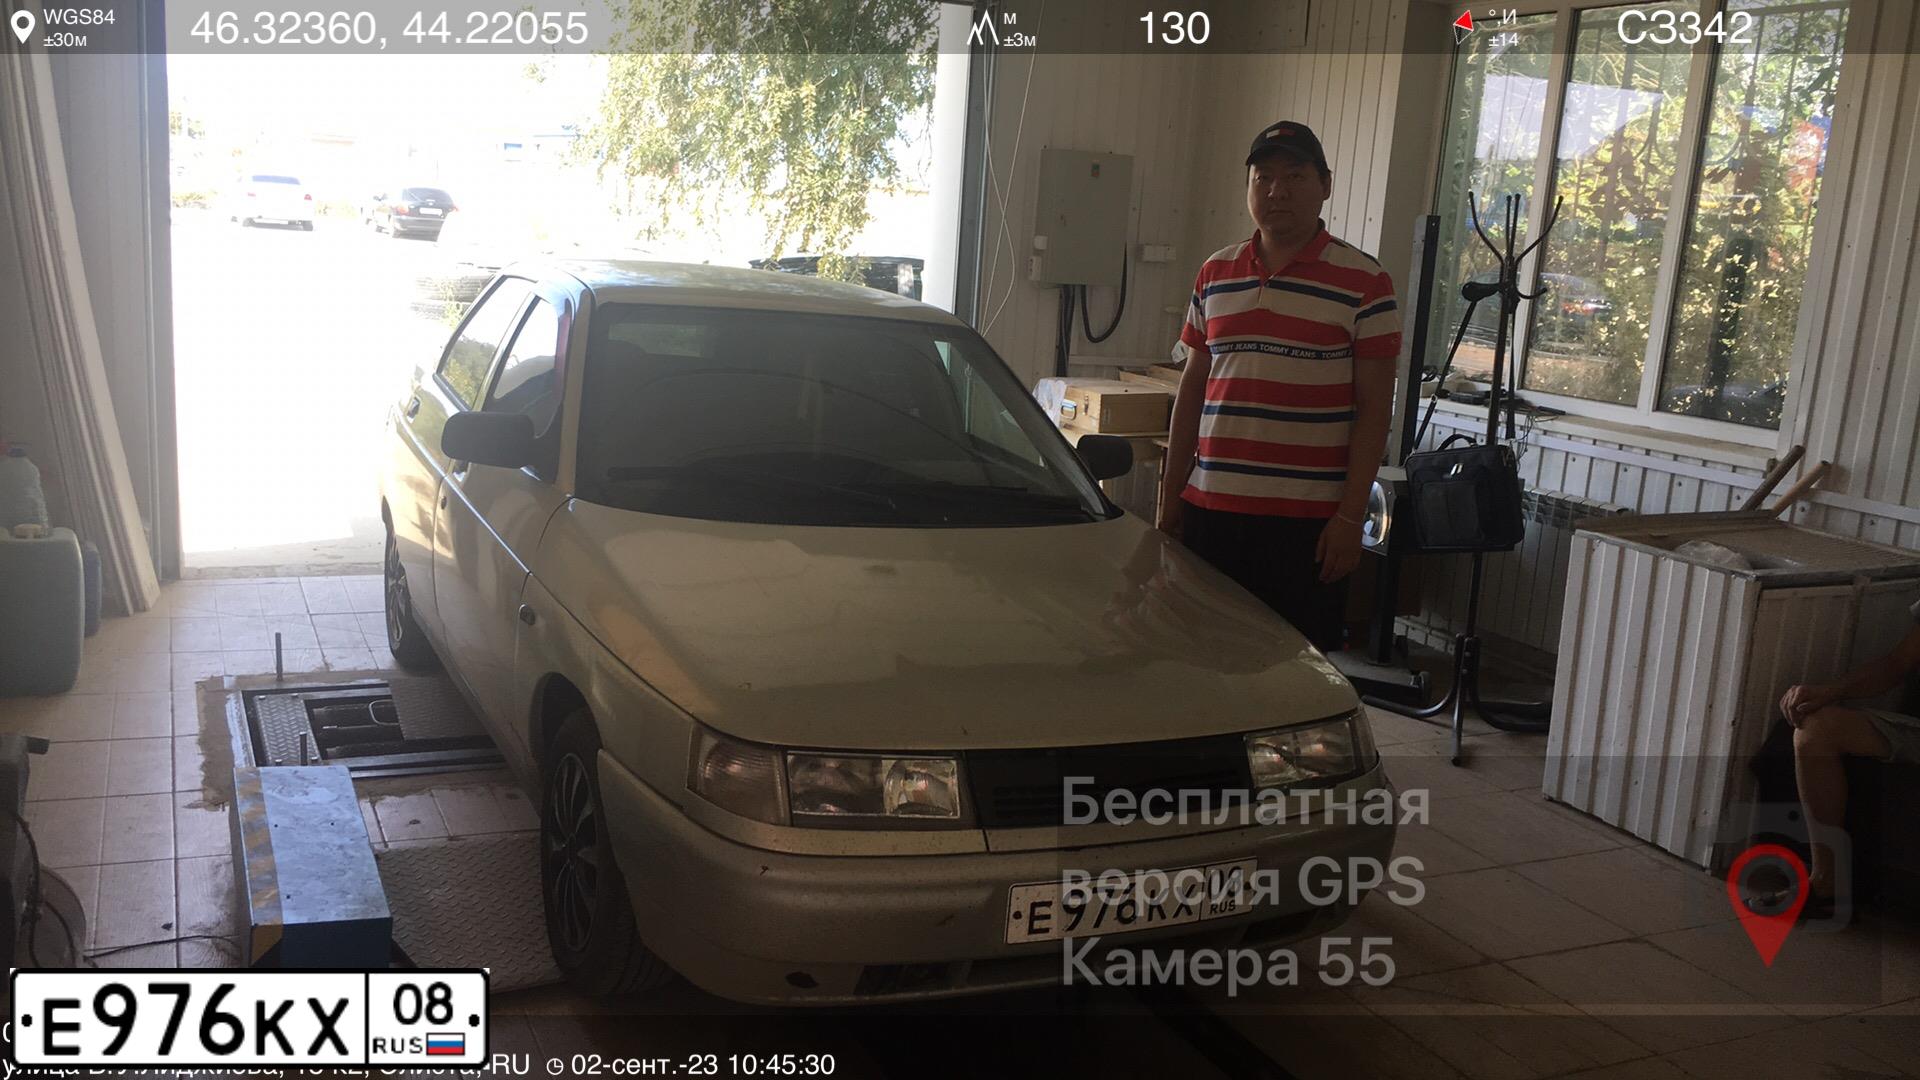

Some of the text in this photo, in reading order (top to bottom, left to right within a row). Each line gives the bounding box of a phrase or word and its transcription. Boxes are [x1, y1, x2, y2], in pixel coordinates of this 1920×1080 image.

[1210, 343, 1233, 352] MMY
[1259, 344, 1289, 355] TOMMY
[1290, 349, 1316, 359] JEANS
[1209, 899, 1237, 915] RUS
